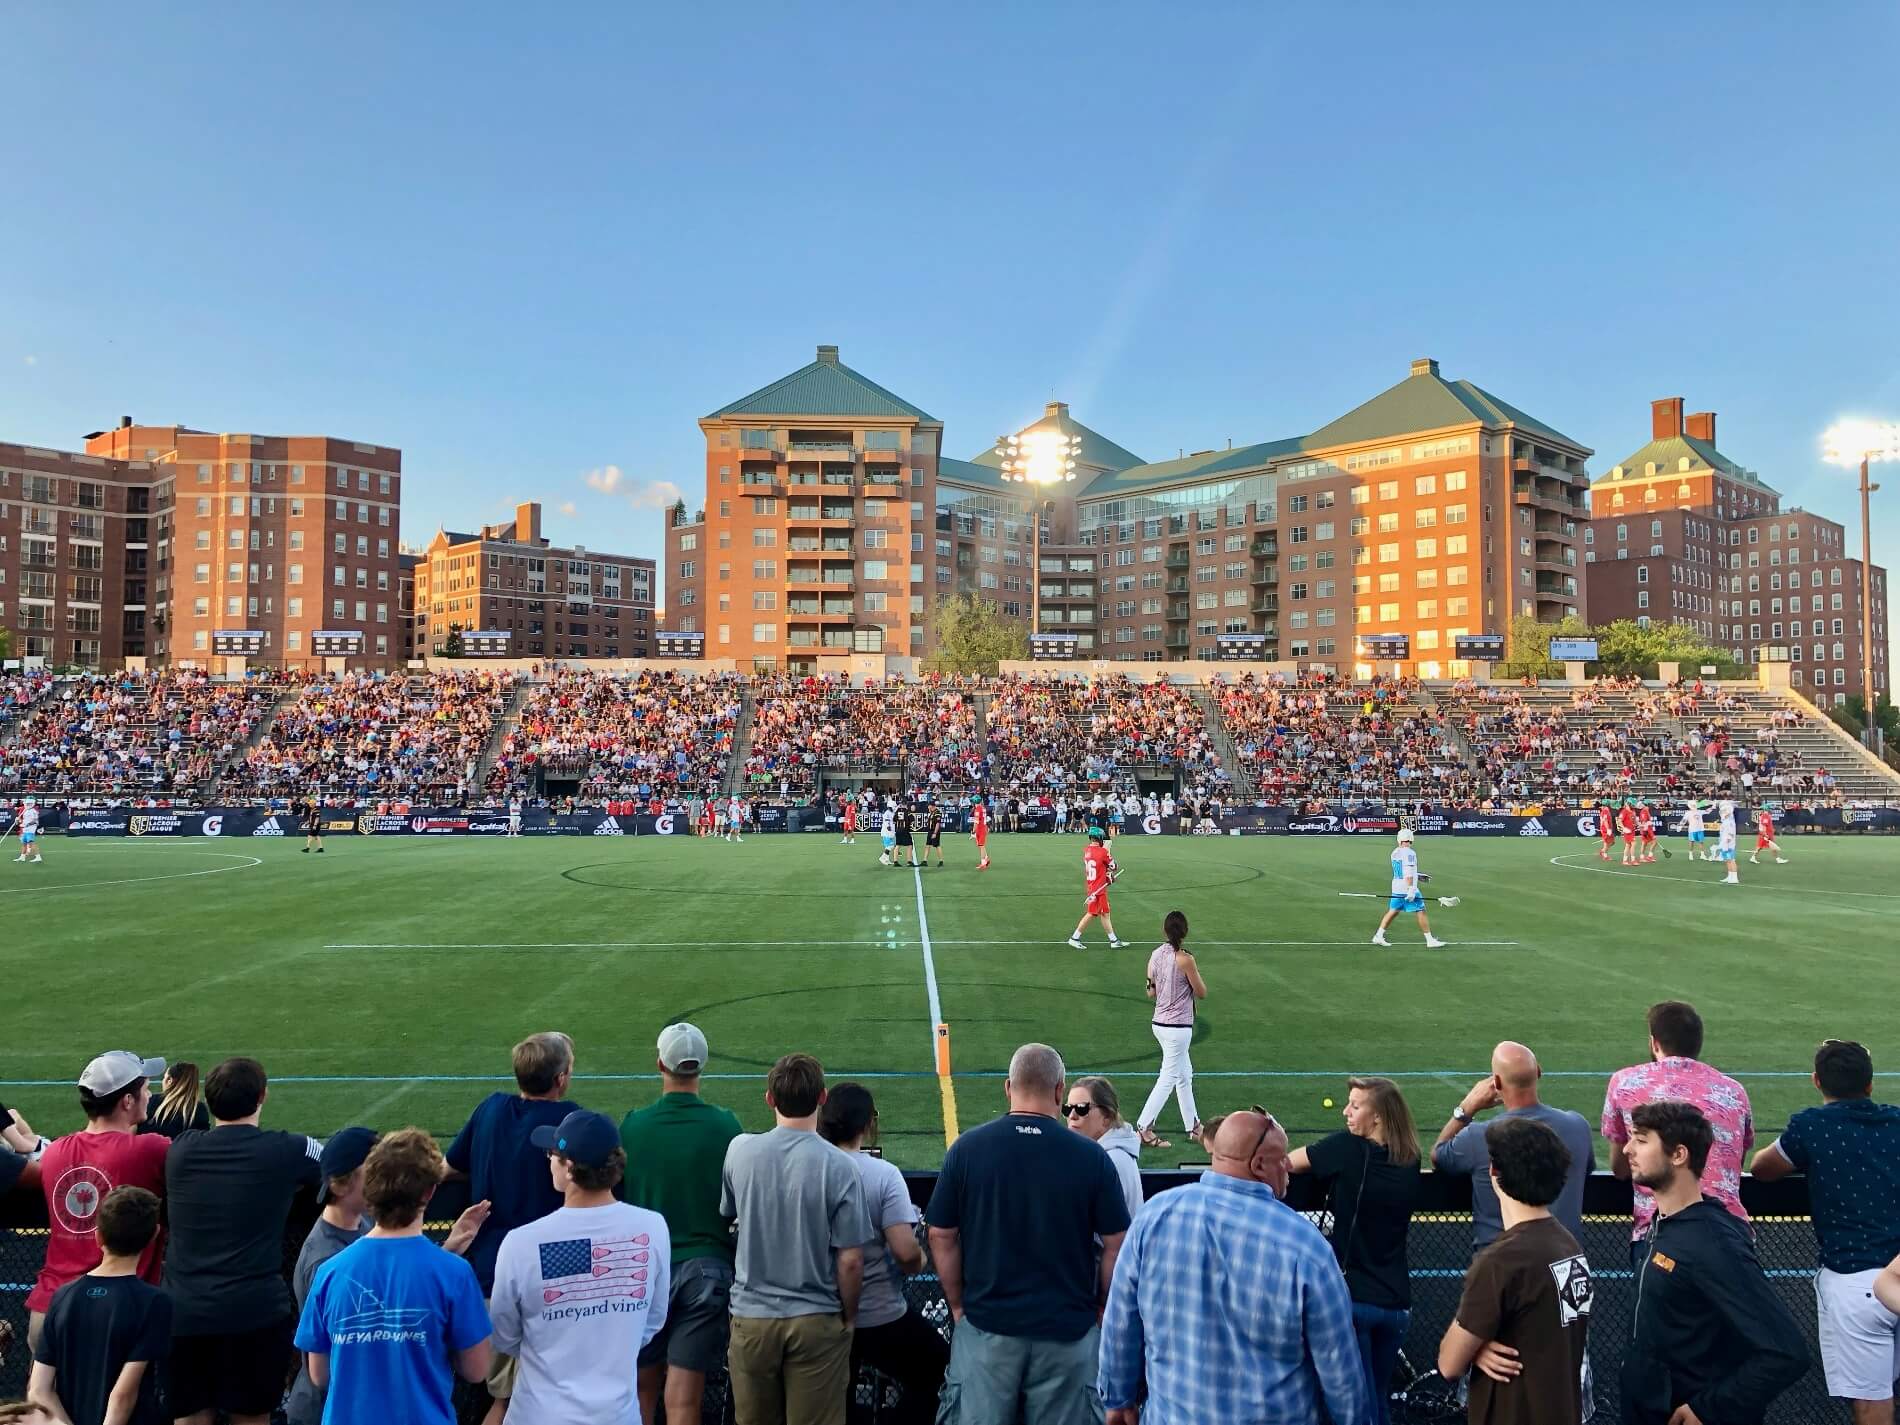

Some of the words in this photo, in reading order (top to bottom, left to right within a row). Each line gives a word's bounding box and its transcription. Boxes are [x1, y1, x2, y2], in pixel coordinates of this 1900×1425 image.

[202, 815, 224, 836] G
[252, 828, 286, 836] adidas
[468, 822, 506, 832] Capital
[593, 828, 624, 836] adidas
[655, 814, 674, 835] G
[1142, 815, 1161, 835] G
[1288, 822, 1324, 832] Capital
[1519, 828, 1549, 836] adidas
[1577, 816, 1597, 837] G
[541, 1299, 609, 1322] vineyard
[611, 1298, 649, 1313] vines
[332, 1330, 392, 1345] INEYARD
